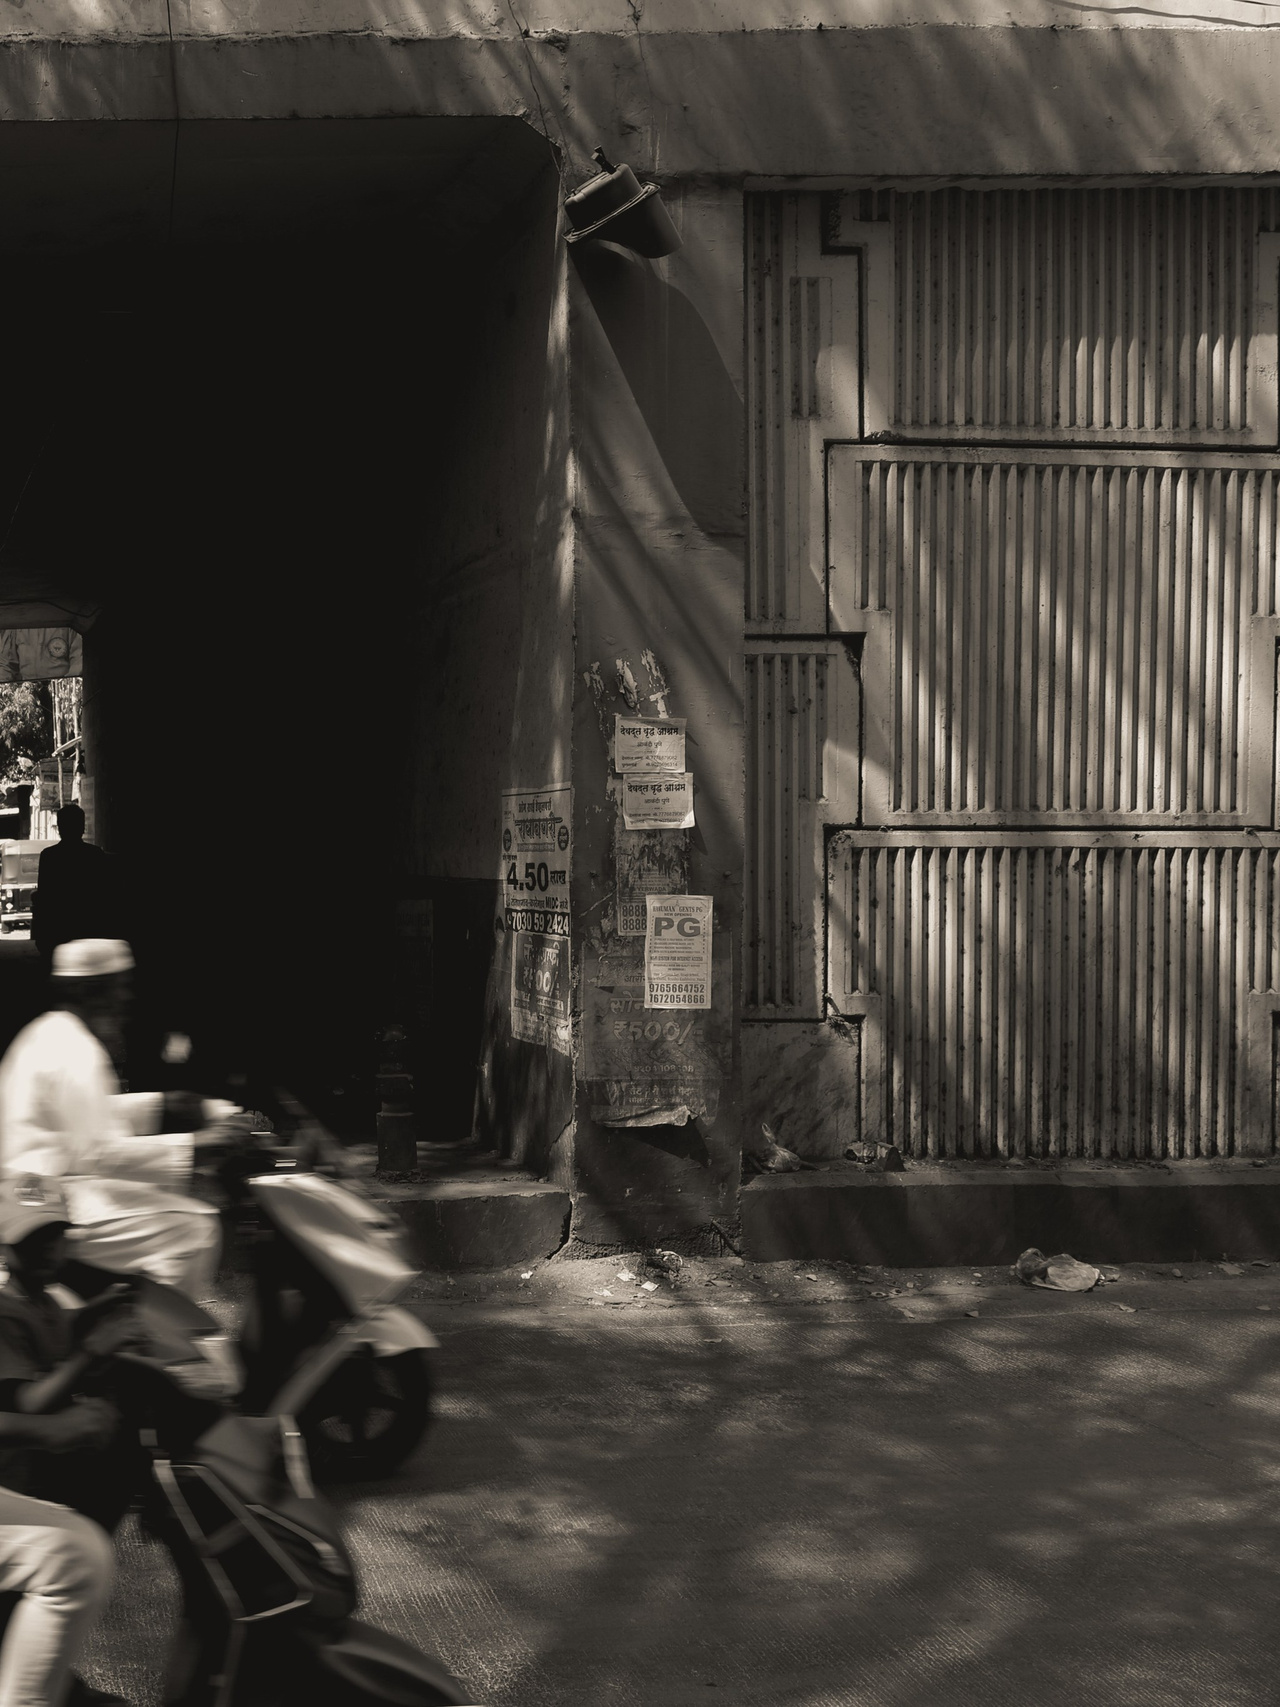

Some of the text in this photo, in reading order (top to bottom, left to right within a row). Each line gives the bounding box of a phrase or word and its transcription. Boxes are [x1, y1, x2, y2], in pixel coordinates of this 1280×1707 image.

[620, 725, 679, 738] देवदूत वृद्ध आश्रम
[627, 782, 686, 795] देवदूत वृद्ध आश्रम
[507, 862, 567, 892] 4.50 लाख
[545, 896, 559, 909] MIDC
[678, 905, 695, 913] GENTS
[511, 912, 569, 936] 7030 59 2424
[654, 917, 701, 938] PG
[649, 983, 705, 993] 9765664752
[649, 994, 705, 1004] 7672054866
